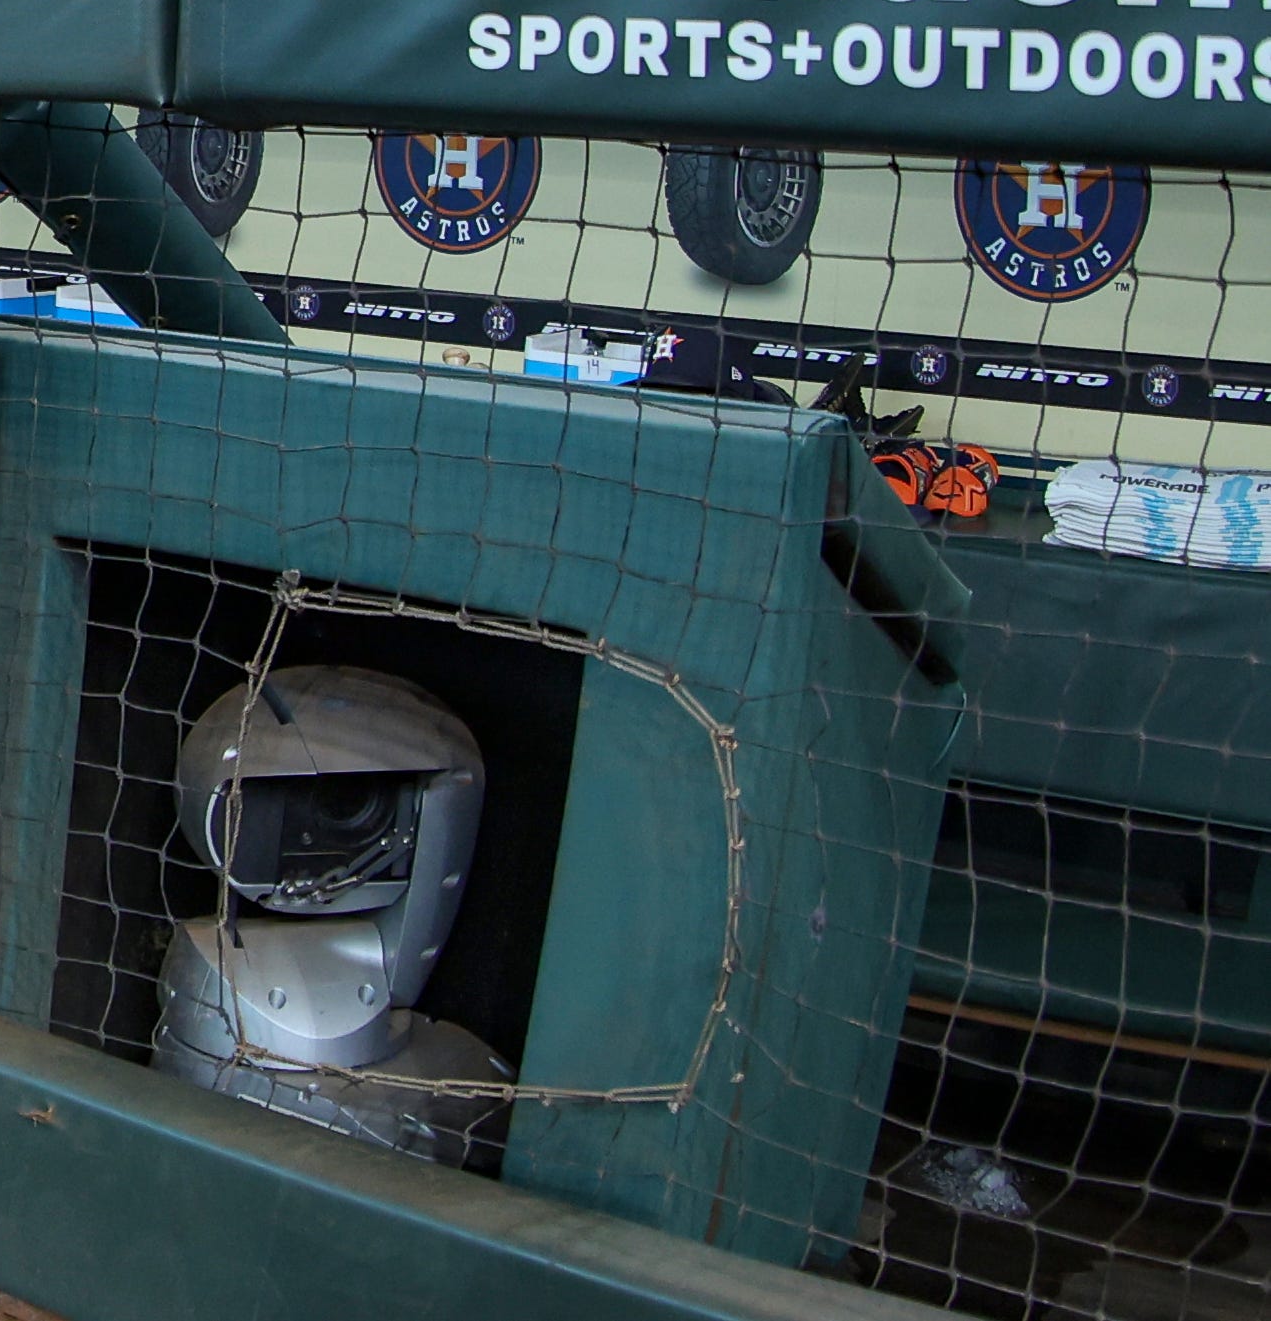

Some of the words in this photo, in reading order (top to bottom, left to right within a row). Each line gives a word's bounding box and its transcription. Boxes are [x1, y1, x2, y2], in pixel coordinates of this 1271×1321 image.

[399, 195, 506, 242] ASTROS
[984, 237, 1112, 289] ASTROS
[344, 302, 457, 324] NITTO
[975, 363, 1111, 388] NITTO
